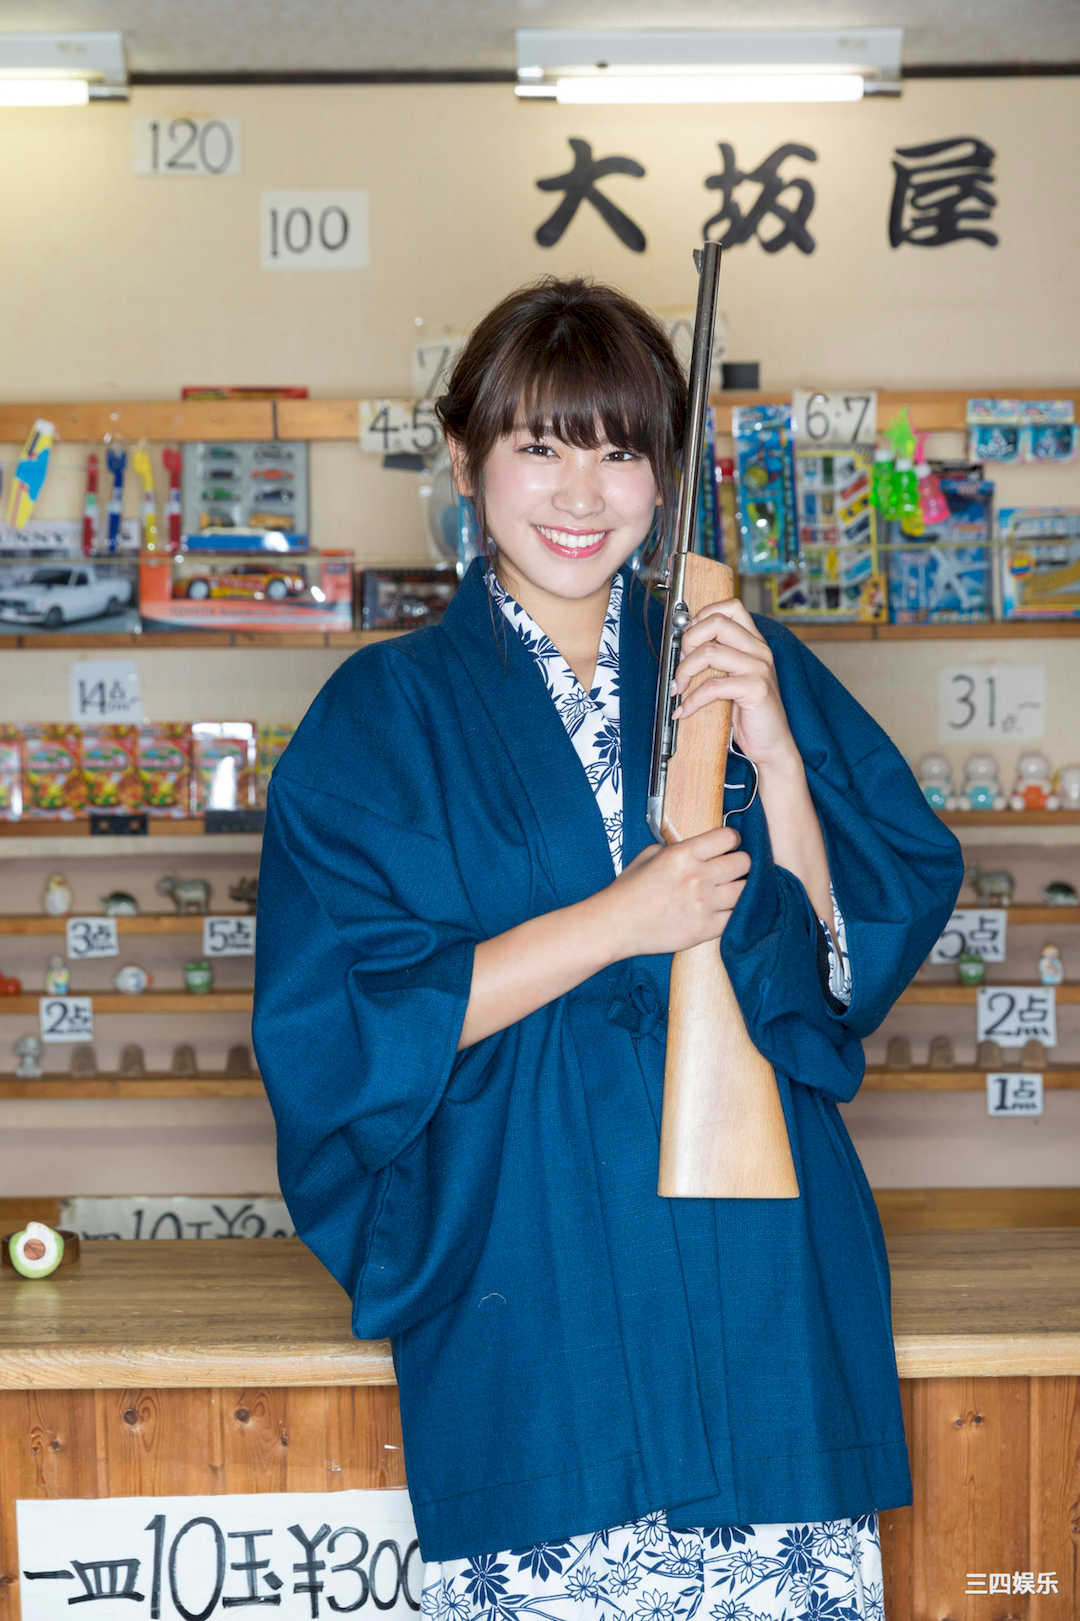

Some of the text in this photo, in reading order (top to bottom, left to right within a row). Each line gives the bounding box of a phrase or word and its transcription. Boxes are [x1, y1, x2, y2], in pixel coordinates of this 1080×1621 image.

[149, 118, 233, 174] 120
[268, 206, 350, 258] 100
[71, 921, 116, 954] 3点
[208, 919, 252, 951] 5点
[45, 1001, 91, 1034] 2点
[985, 992, 1050, 1036] 2点
[994, 1077, 1037, 1111] 1点
